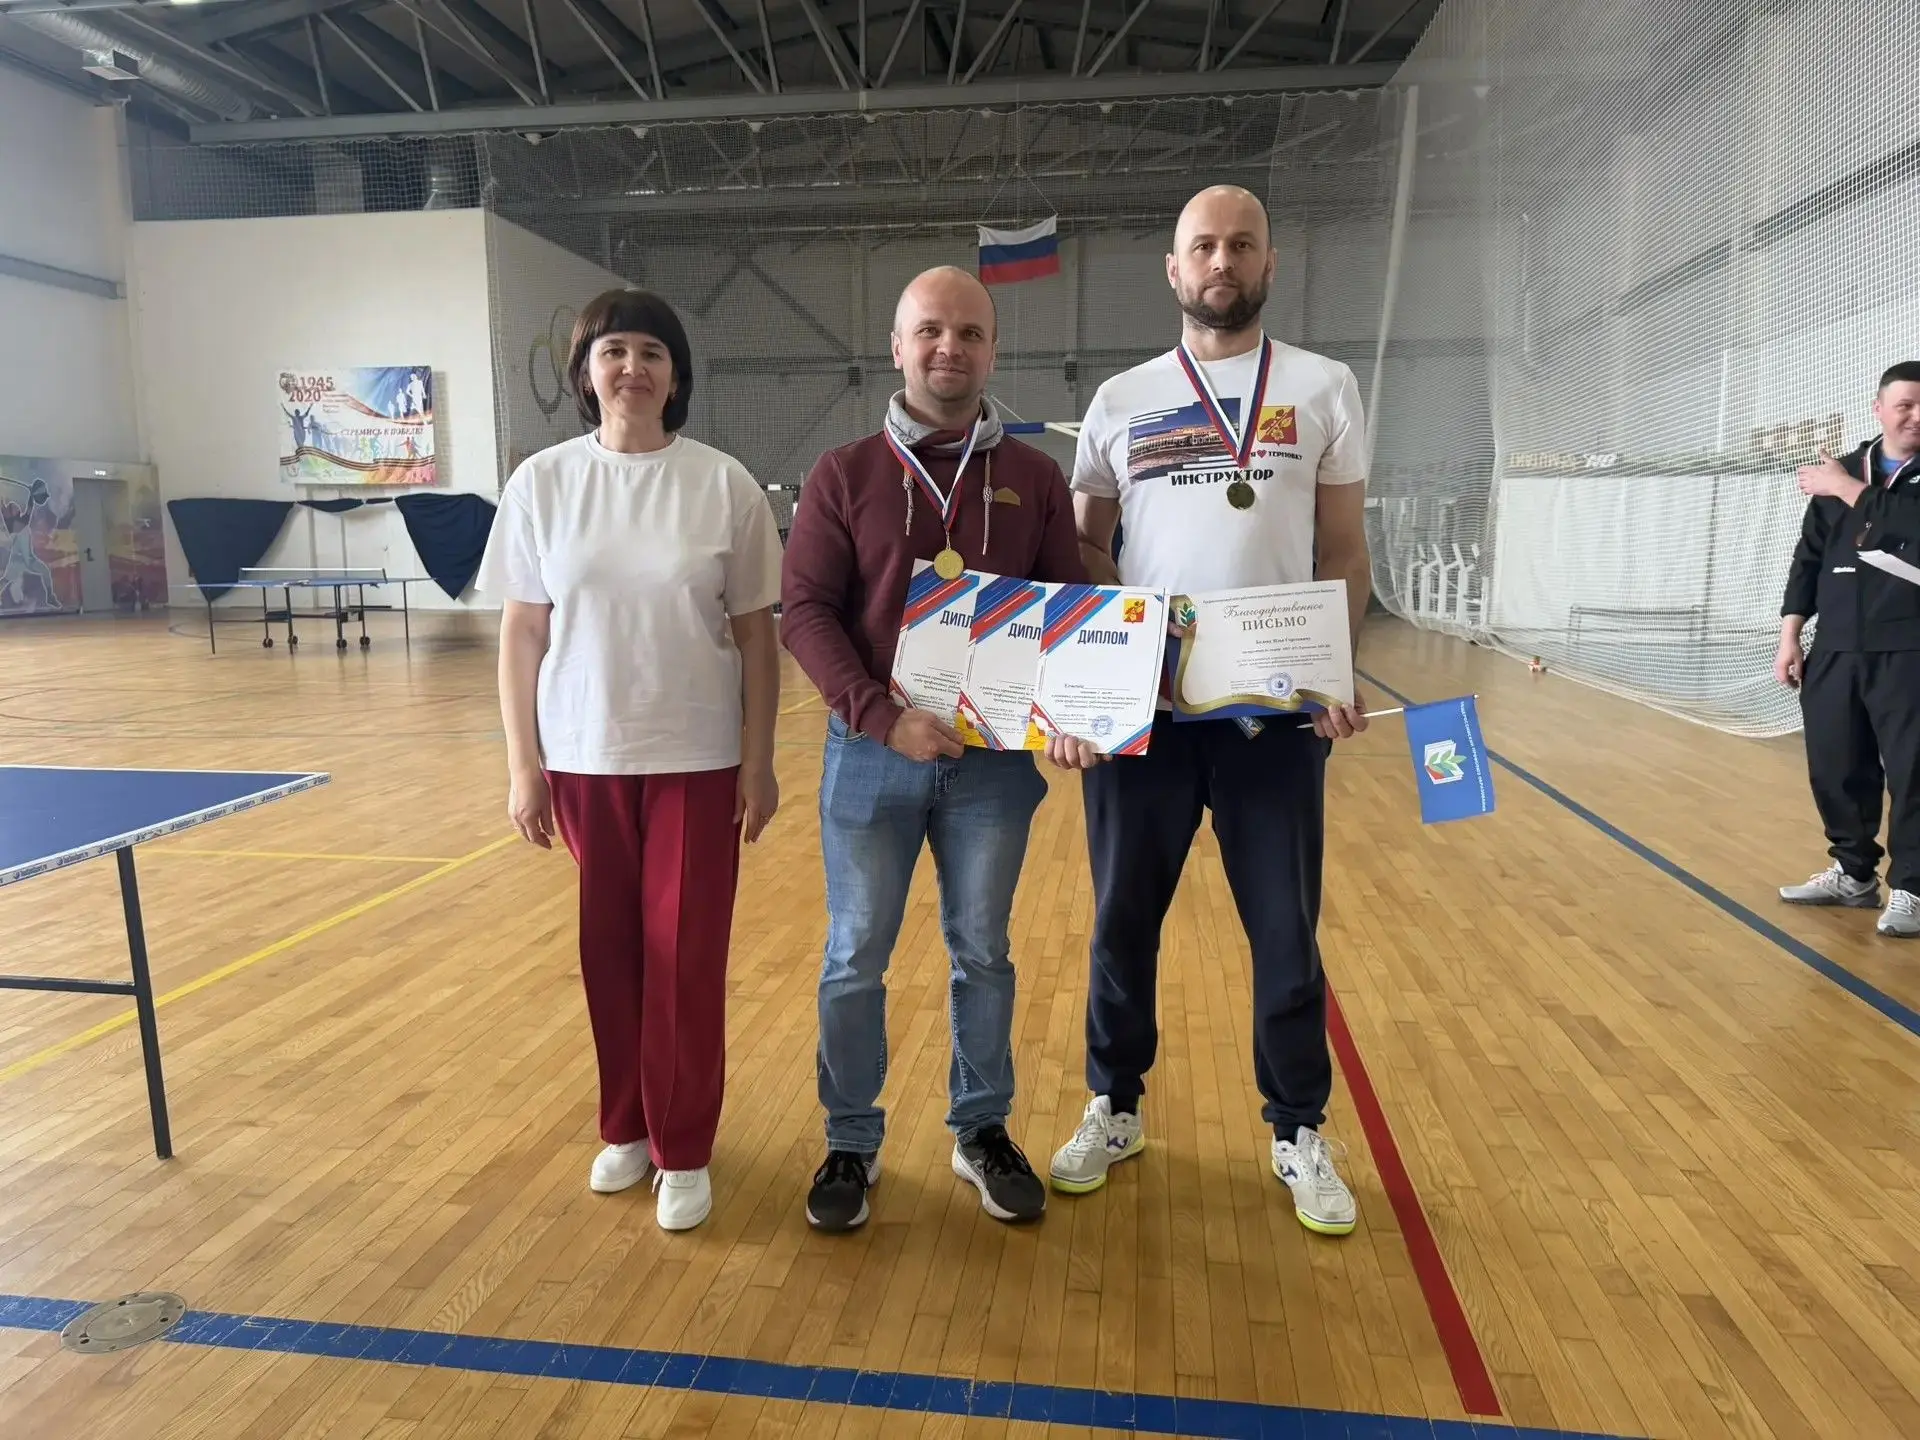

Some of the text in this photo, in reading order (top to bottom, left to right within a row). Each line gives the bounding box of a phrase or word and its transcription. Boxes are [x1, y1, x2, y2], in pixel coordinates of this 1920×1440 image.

[300, 376, 334, 390] 1945
[288, 388, 321, 402] 2020
[1171, 469, 1274, 486] ИНСТРУКТОР
[1224, 601, 1324, 618] Благодарственное
[1242, 615, 1307, 631] ПИСЬМО
[1077, 629, 1128, 645] ДИПЛОМ
